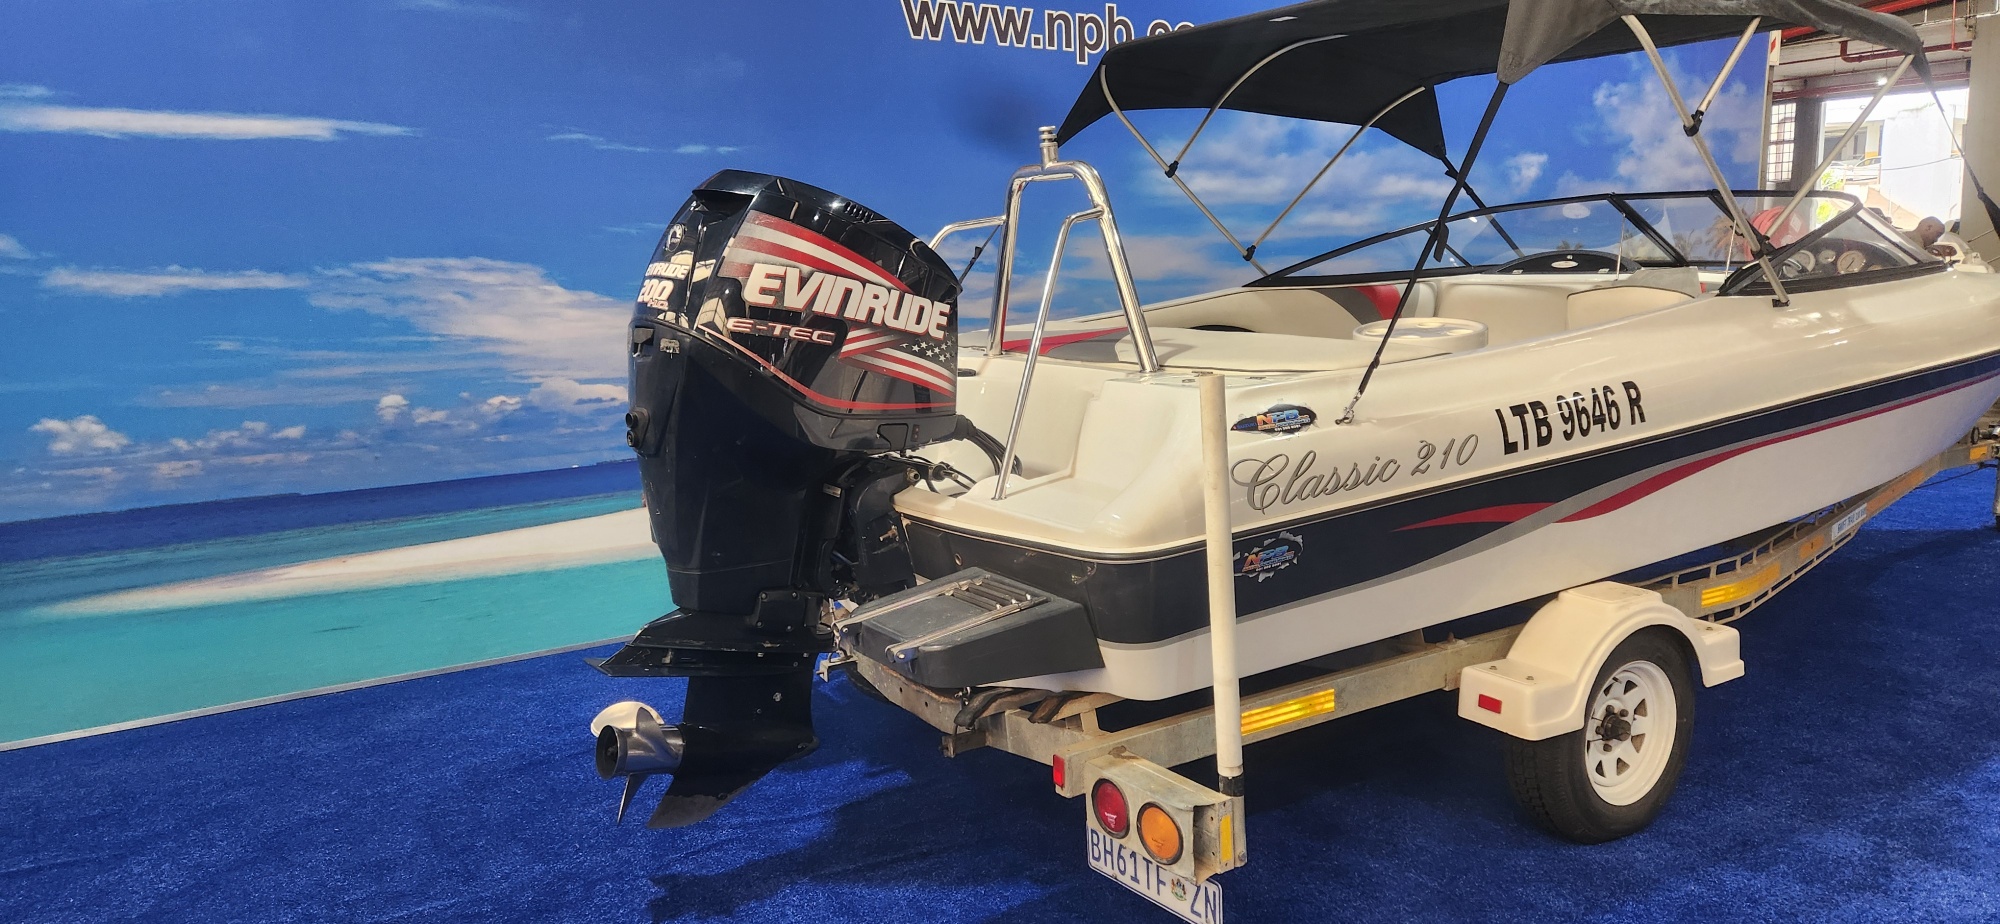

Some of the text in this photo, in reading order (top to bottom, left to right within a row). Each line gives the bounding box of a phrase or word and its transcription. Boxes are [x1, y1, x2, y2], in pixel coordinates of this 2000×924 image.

[637, 279, 674, 303] 200
[743, 262, 951, 341] EVINRUDE
[726, 317, 836, 345] E-TEC
[1256, 409, 1300, 426] NPB
[1495, 380, 1646, 455] LTB 9646 R
[1230, 434, 1479, 515] Classic 210
[1190, 885, 1217, 924] ZN
